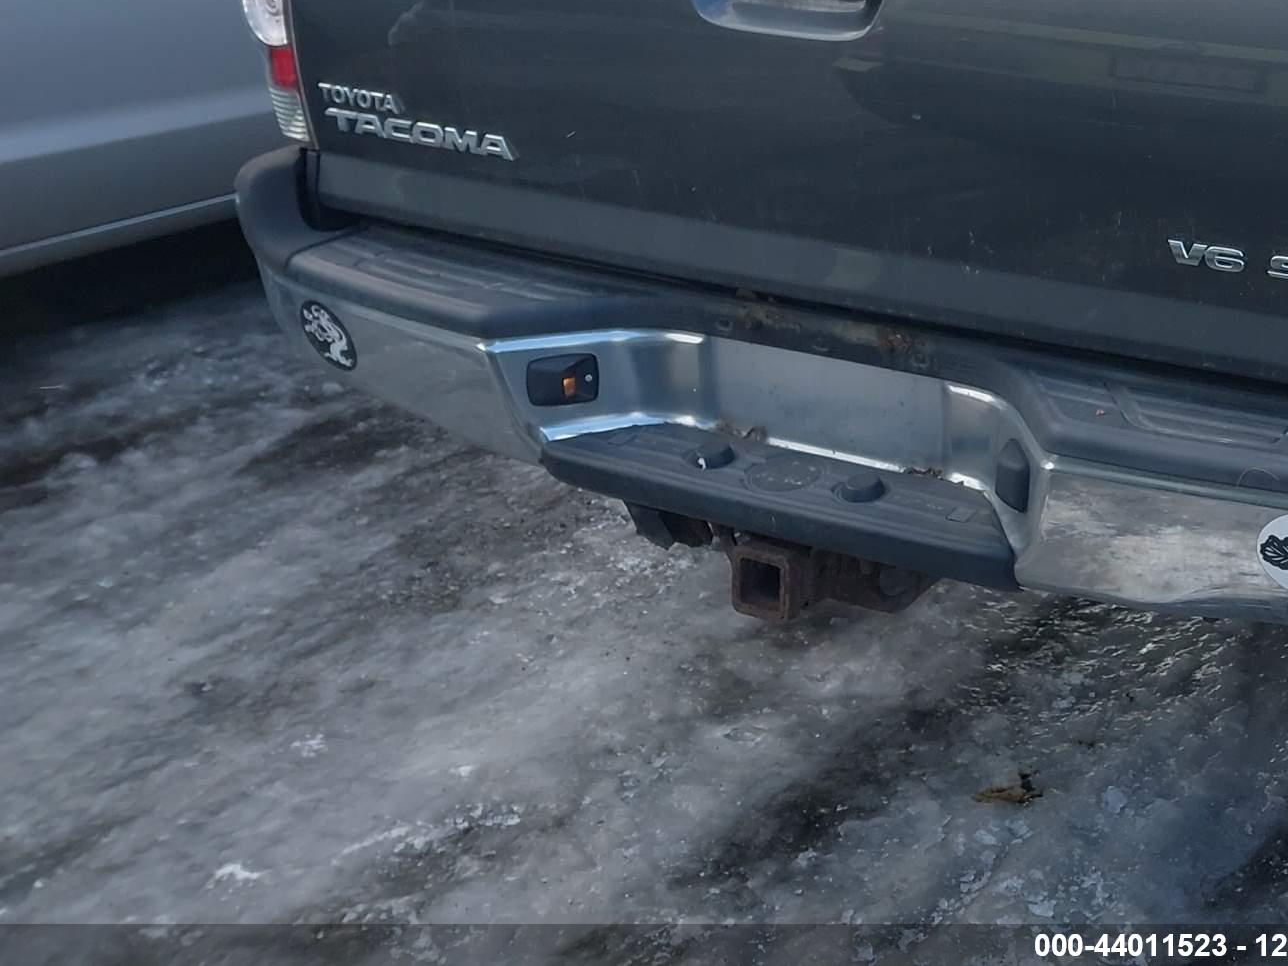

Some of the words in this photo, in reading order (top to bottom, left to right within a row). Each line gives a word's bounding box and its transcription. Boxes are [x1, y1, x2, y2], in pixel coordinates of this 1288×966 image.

[317, 81, 401, 115] TOYOTA
[324, 107, 517, 162] TACOMA
[1167, 238, 1246, 273] V6
